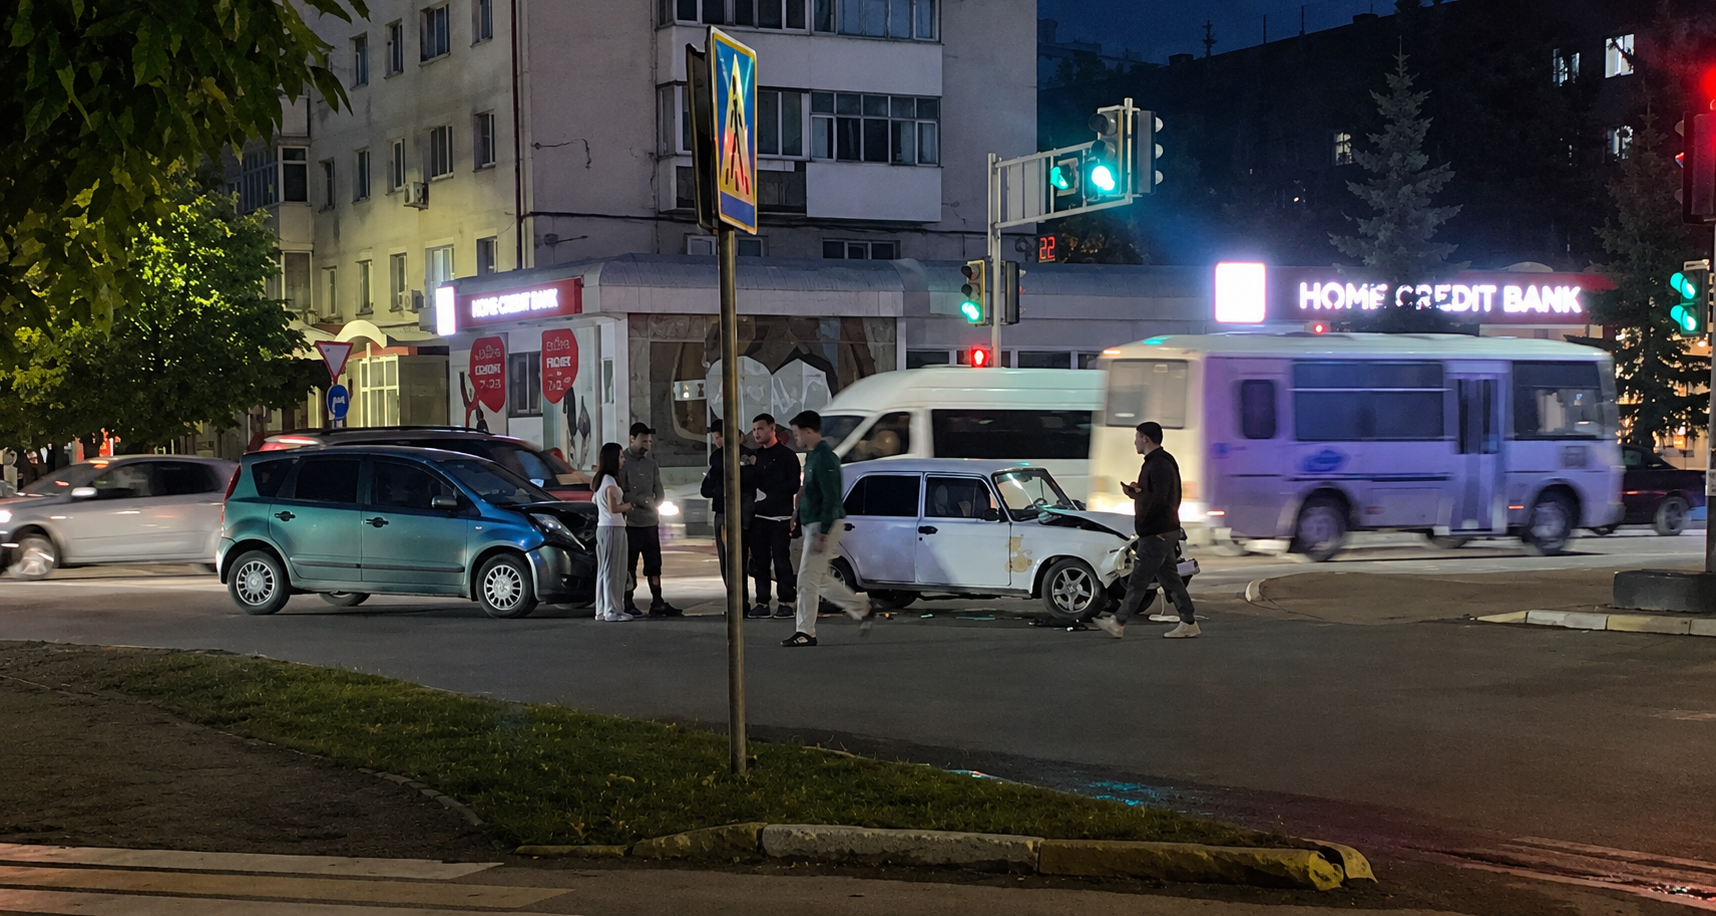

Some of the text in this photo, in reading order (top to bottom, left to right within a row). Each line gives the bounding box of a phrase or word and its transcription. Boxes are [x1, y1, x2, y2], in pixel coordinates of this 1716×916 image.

[1040, 236, 1055, 260] 22
[472, 288, 558, 318] HOME CREDIT BANK
[1299, 282, 1582, 313] HOME CREDIT BANK
